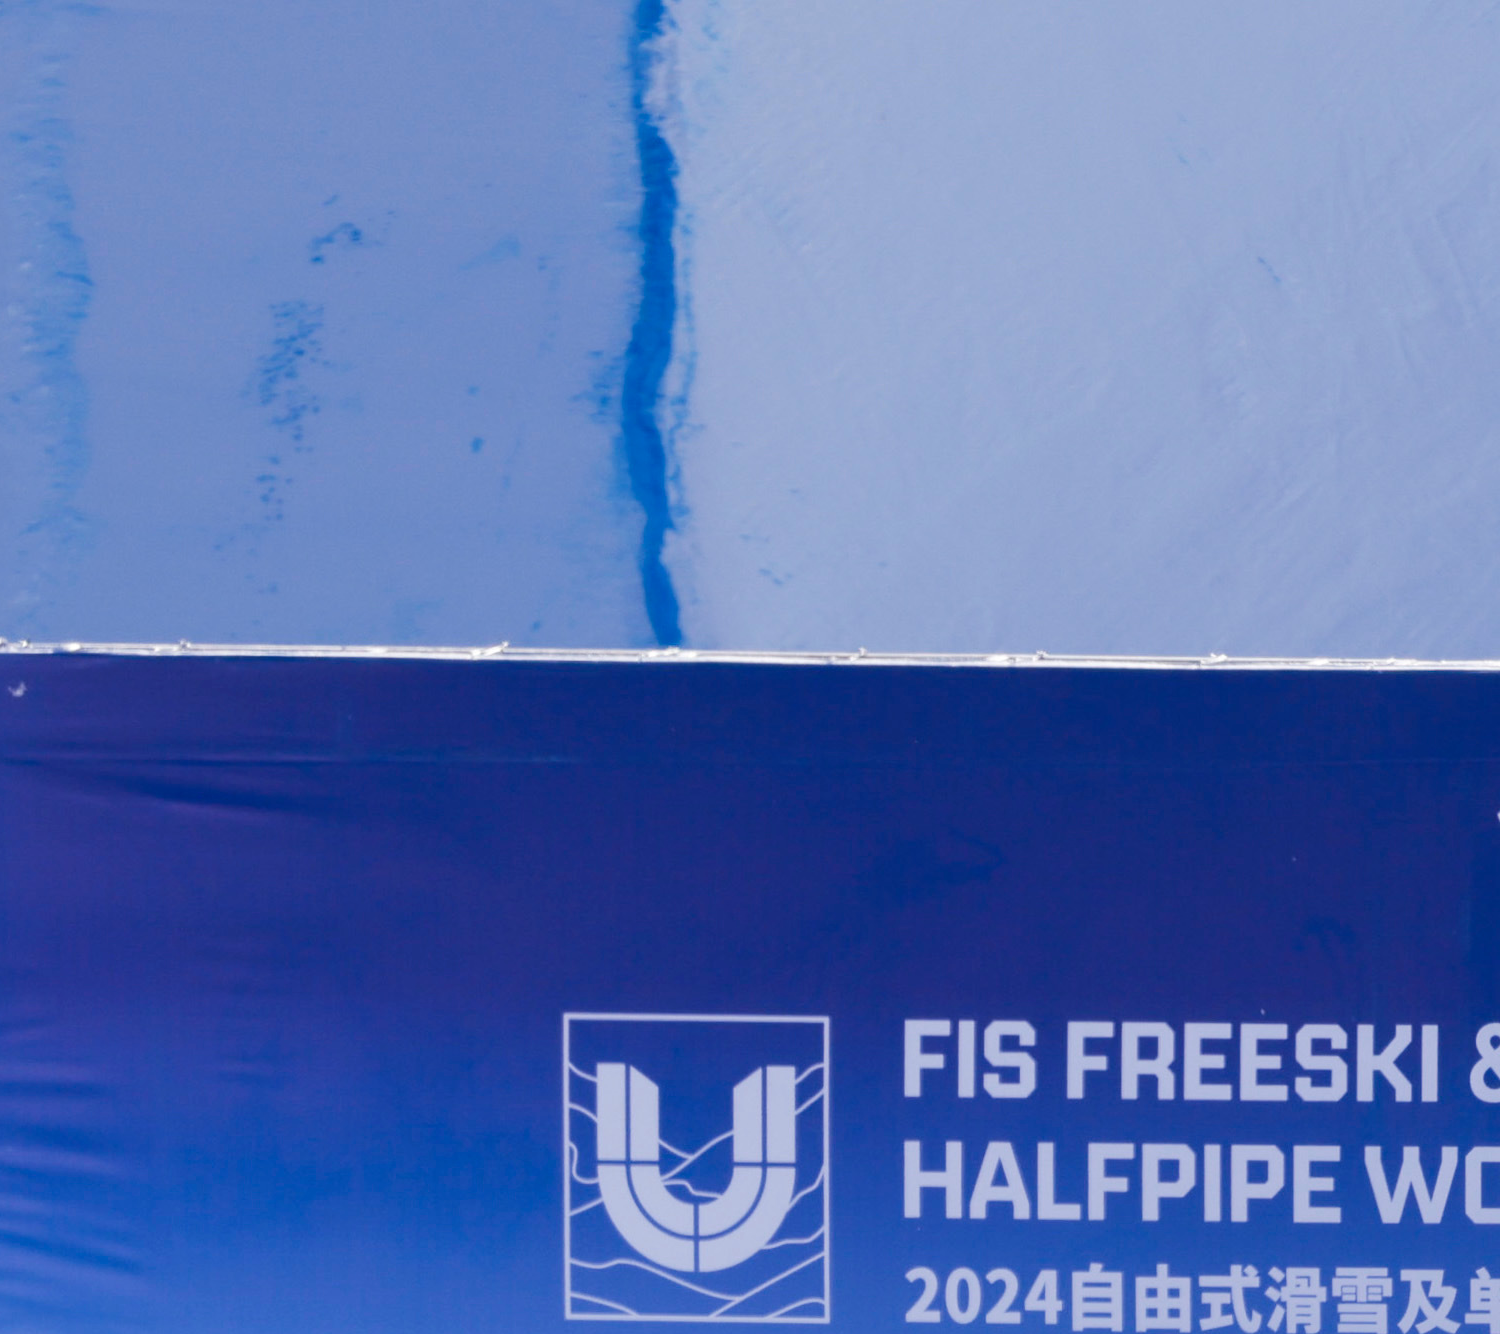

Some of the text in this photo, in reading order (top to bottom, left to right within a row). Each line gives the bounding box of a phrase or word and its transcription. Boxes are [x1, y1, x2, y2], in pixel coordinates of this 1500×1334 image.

[903, 1019, 1037, 1099] FIS
[1066, 1020, 1439, 1103] FREESKI
[903, 1139, 1342, 1224] HALFPIPE
